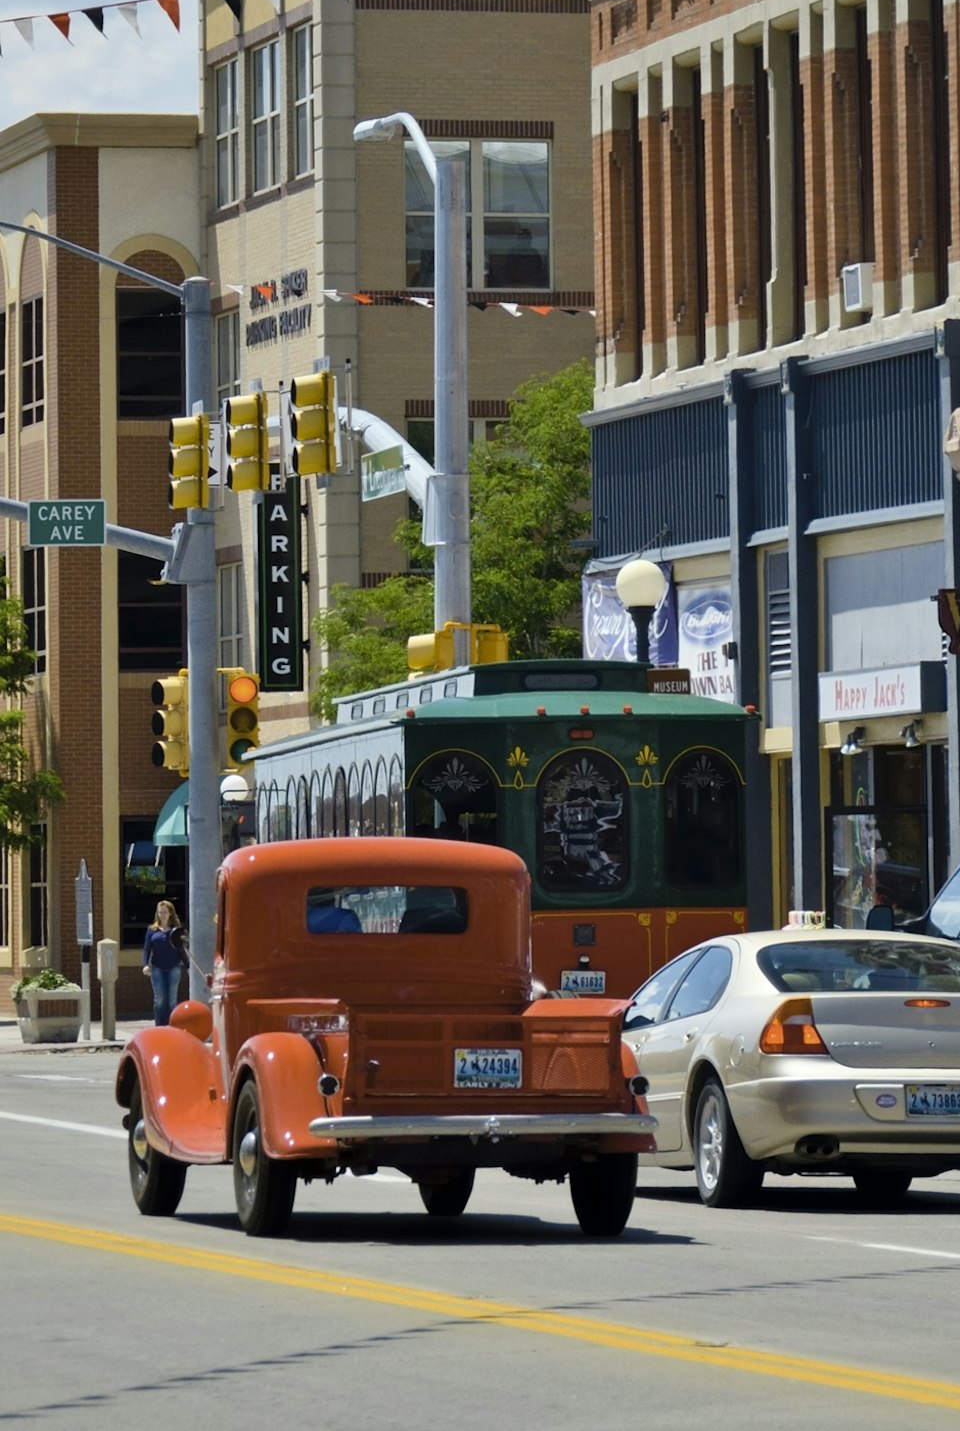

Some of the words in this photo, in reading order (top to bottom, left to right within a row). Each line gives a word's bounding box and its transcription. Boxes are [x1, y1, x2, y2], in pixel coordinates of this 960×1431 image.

[38, 505, 96, 521] CAREY
[50, 525, 85, 541] AVE
[697, 650, 718, 672] THE
[653, 681, 688, 693] MUSEUM
[482, 1057, 518, 1075] 24394
